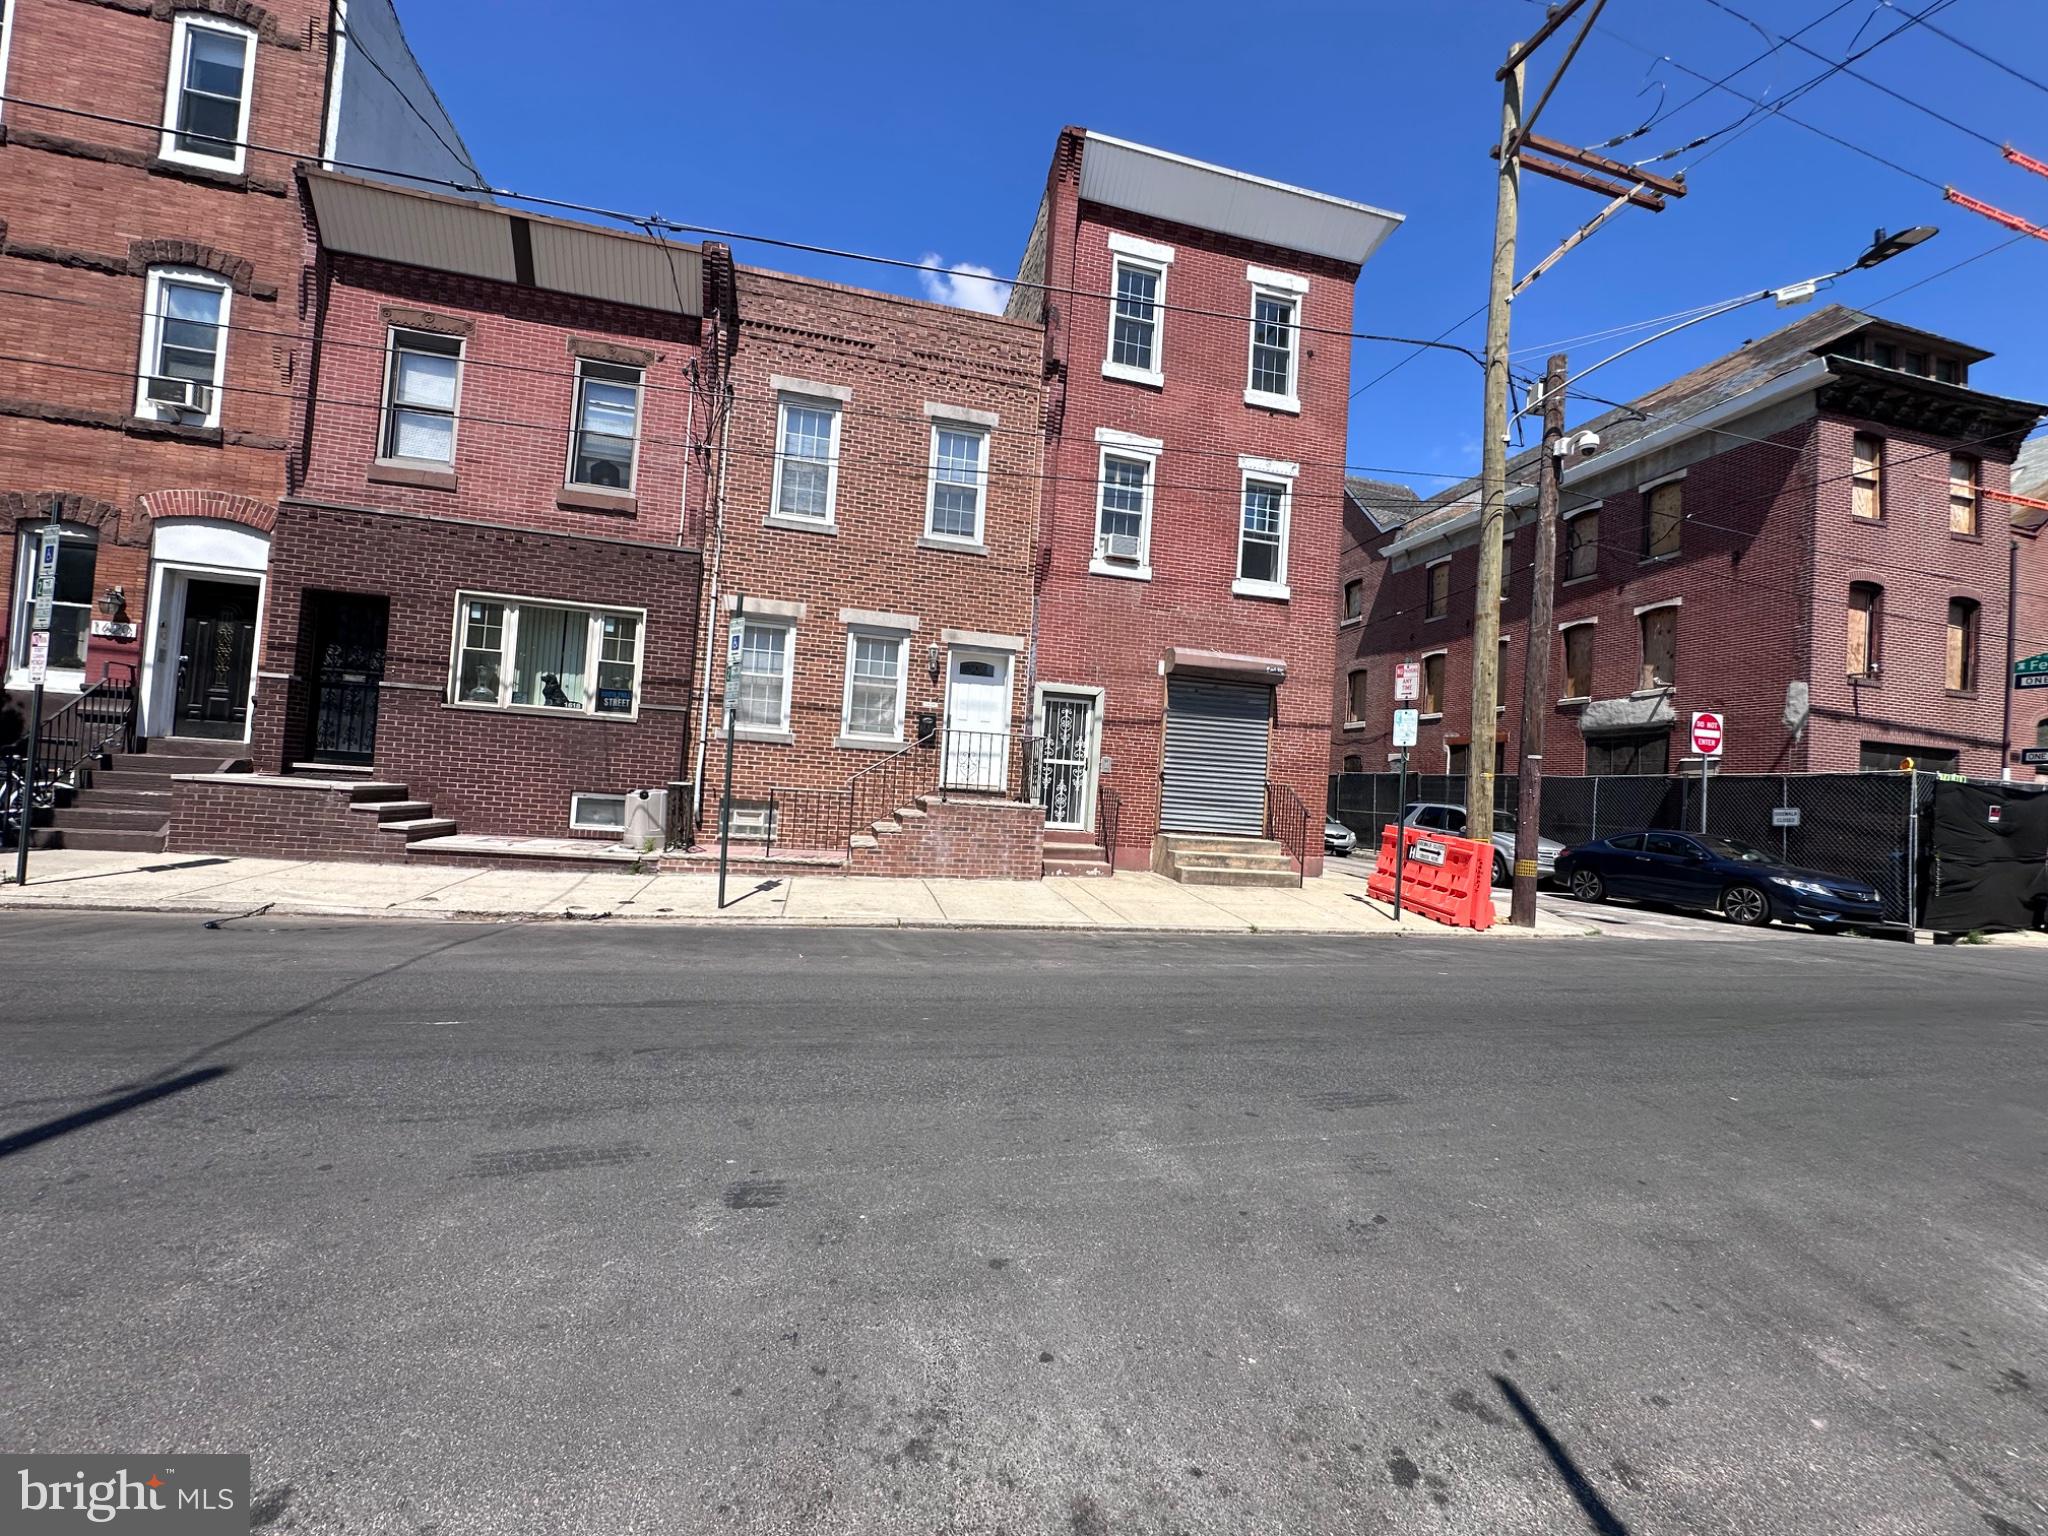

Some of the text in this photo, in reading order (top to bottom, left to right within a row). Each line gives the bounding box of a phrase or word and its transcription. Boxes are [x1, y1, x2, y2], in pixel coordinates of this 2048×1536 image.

[603, 697, 630, 707] STREET
[1696, 720, 1718, 729] DO NOT
[1697, 738, 1716, 746] ENTER
